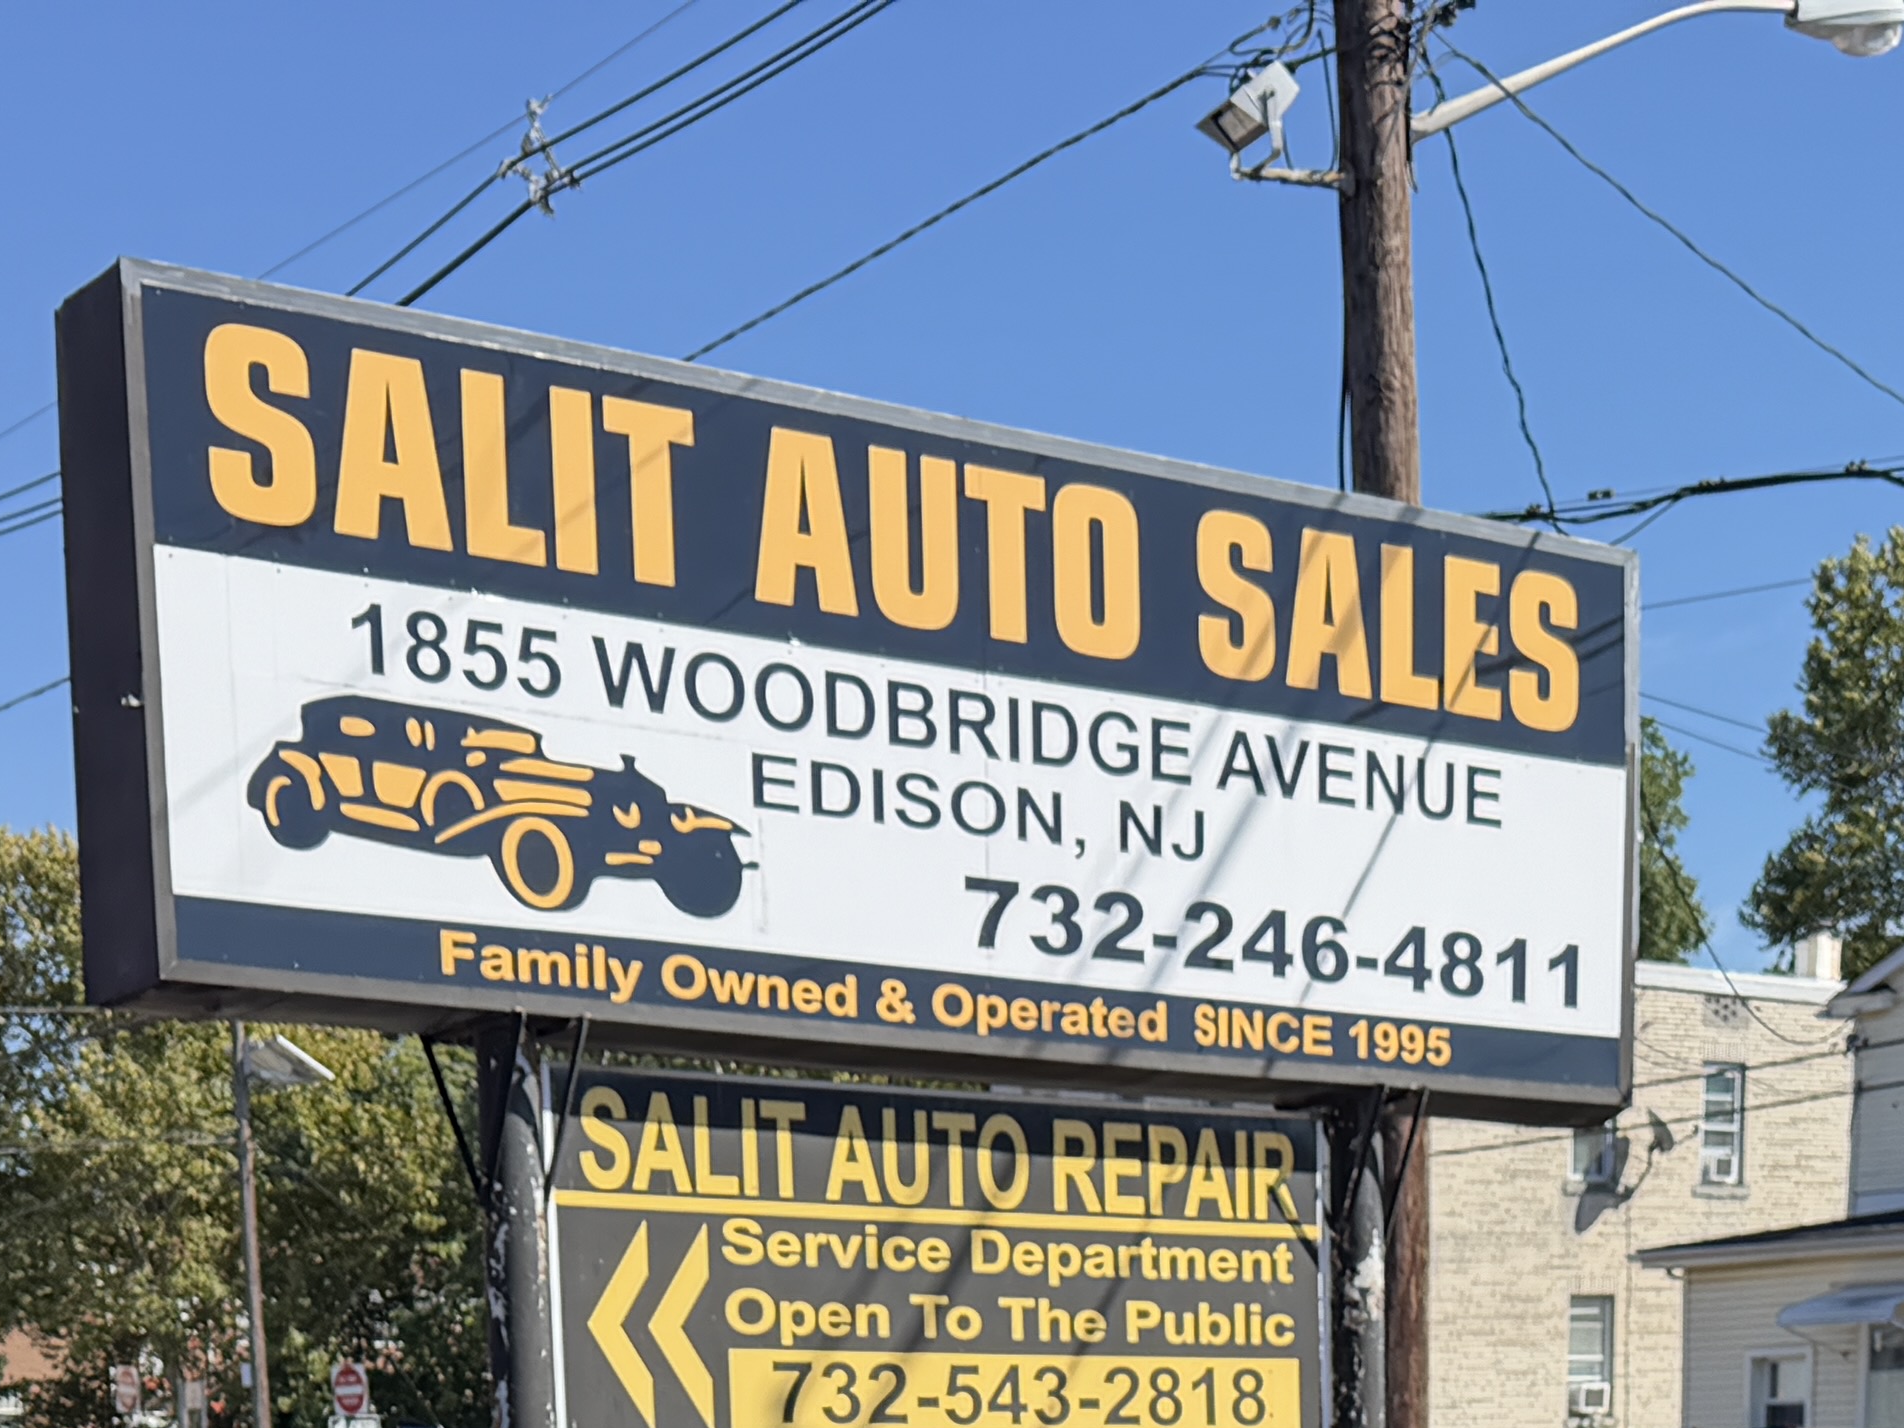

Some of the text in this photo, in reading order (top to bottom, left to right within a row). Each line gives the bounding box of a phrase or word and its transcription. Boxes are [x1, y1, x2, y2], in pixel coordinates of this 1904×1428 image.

[203, 322, 1579, 733] SALIT AUTO SALES
[351, 603, 1503, 829] 1855 WOODBRIDGE AVENUE
[751, 752, 1206, 861] EDISON, NJ
[439, 929, 1453, 1068] Family Owned & Operated SINCE 1995
[963, 876, 1579, 1009] 732-246-4811
[578, 1086, 1296, 1222] SALIT AUTO REPAIR
[720, 1217, 1295, 1288] Service Department
[723, 1287, 1296, 1347] Open To The Public
[772, 1359, 1266, 1426] 732-543-2818
